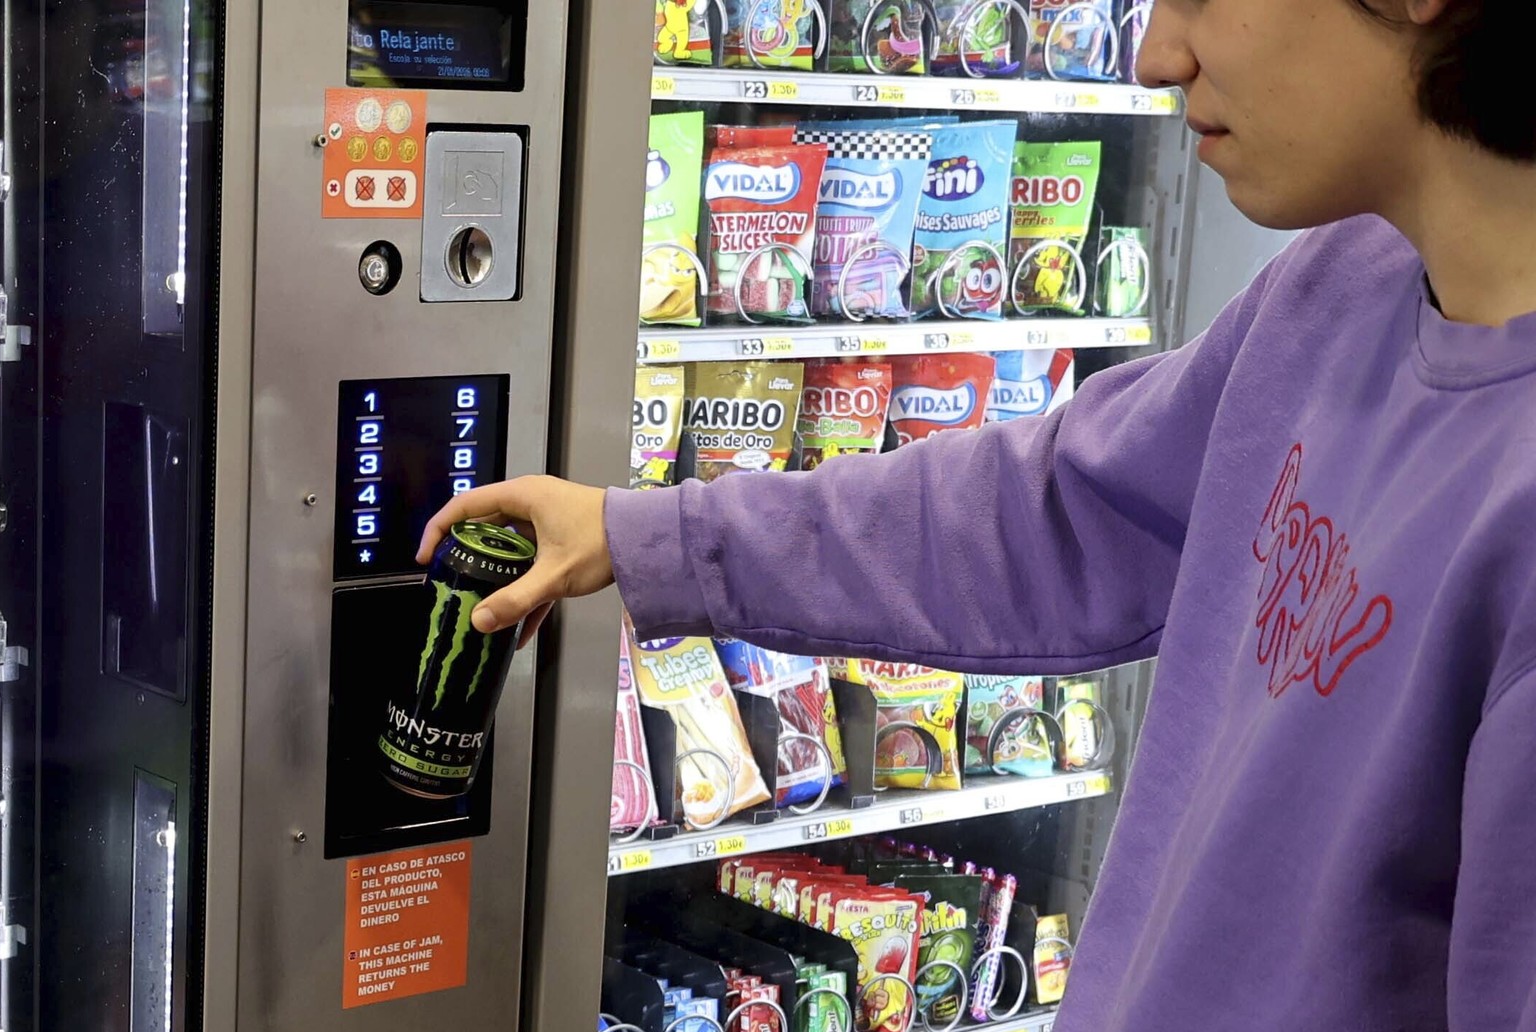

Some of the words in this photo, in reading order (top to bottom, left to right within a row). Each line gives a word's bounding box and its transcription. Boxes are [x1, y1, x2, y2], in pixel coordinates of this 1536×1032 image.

[713, 174, 787, 193] VIDAL
[819, 178, 888, 199] VIDAL
[943, 205, 1001, 232] Sauvages
[364, 392, 376, 412] 1
[457, 388, 475, 408] 6
[897, 394, 964, 414] VIDAL
[360, 423, 379, 444] 2
[455, 418, 474, 438] 7
[359, 454, 378, 475] 3
[454, 448, 472, 468] 8
[358, 485, 376, 505] 4
[357, 515, 375, 535] 5
[450, 546, 474, 563] ZERO
[480, 561, 517, 575] SUGAR
[387, 699, 484, 749] MONSTER
[387, 729, 465, 762] ENERGY
[416, 761, 468, 776] SUGAR
[697, 841, 715, 856] 52
[362, 866, 376, 876] EN
[379, 861, 407, 874] CASO
[410, 858, 423, 868] DE
[426, 851, 465, 866] ATASCO
[362, 878, 381, 889] DEL
[384, 868, 442, 886] PRODUCTO,
[361, 889, 387, 902] ESTA
[390, 881, 438, 897] MÁQUINA
[360, 898, 414, 915] DEVUELVE
[417, 895, 429, 905] EL
[360, 913, 399, 928] DINERO
[359, 948, 370, 958] IN
[373, 942, 400, 955] CASE
[403, 939, 417, 950] OF
[419, 935, 443, 947] JAM,
[358, 958, 383, 971] THIS
[385, 949, 433, 965] MACHINE
[358, 966, 407, 984] RETURNS
[409, 962, 430, 973] THE
[358, 981, 395, 996] MONEY
